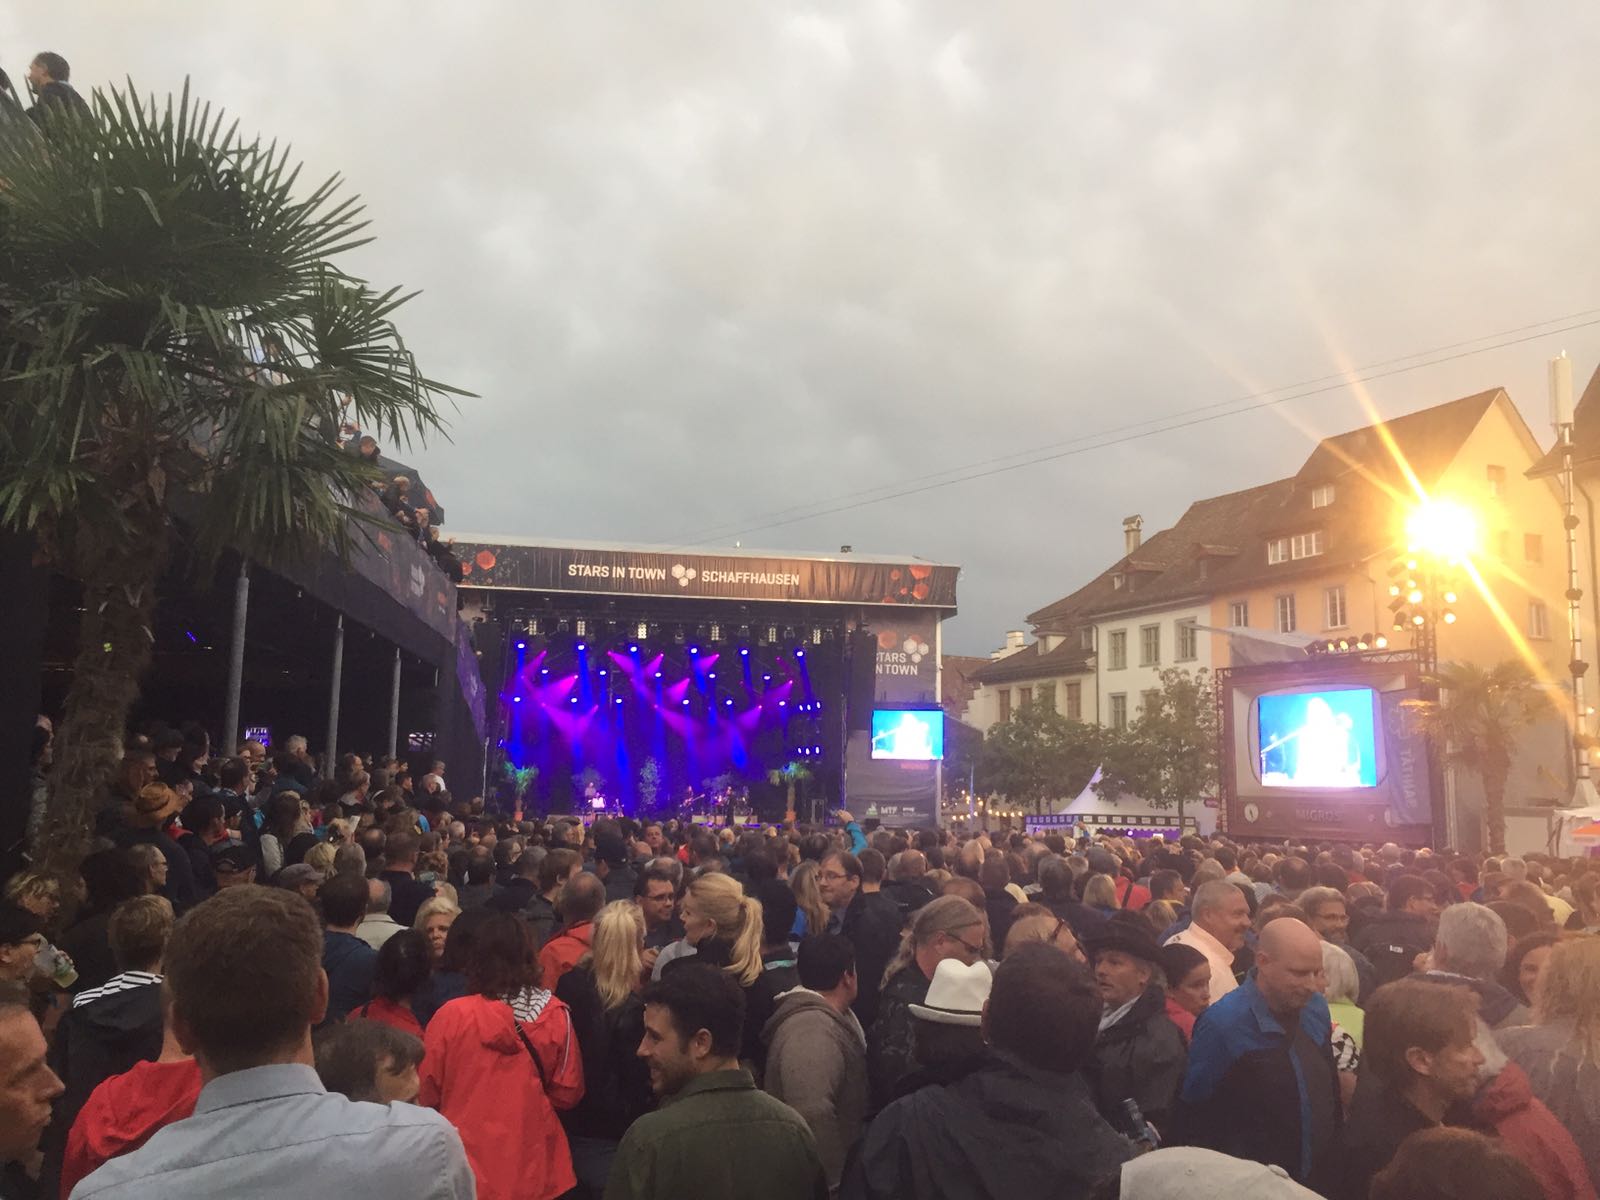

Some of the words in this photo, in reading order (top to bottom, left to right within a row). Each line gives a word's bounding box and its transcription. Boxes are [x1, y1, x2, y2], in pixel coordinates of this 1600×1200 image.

[568, 564, 610, 578] STARS
[612, 566, 625, 578] IN
[628, 567, 667, 580] TOWN
[701, 570, 800, 586] SCHAFFHAUSEN
[885, 664, 918, 676] TOWN
[881, 806, 898, 814] MTF
[1295, 808, 1342, 822] MIGROS
